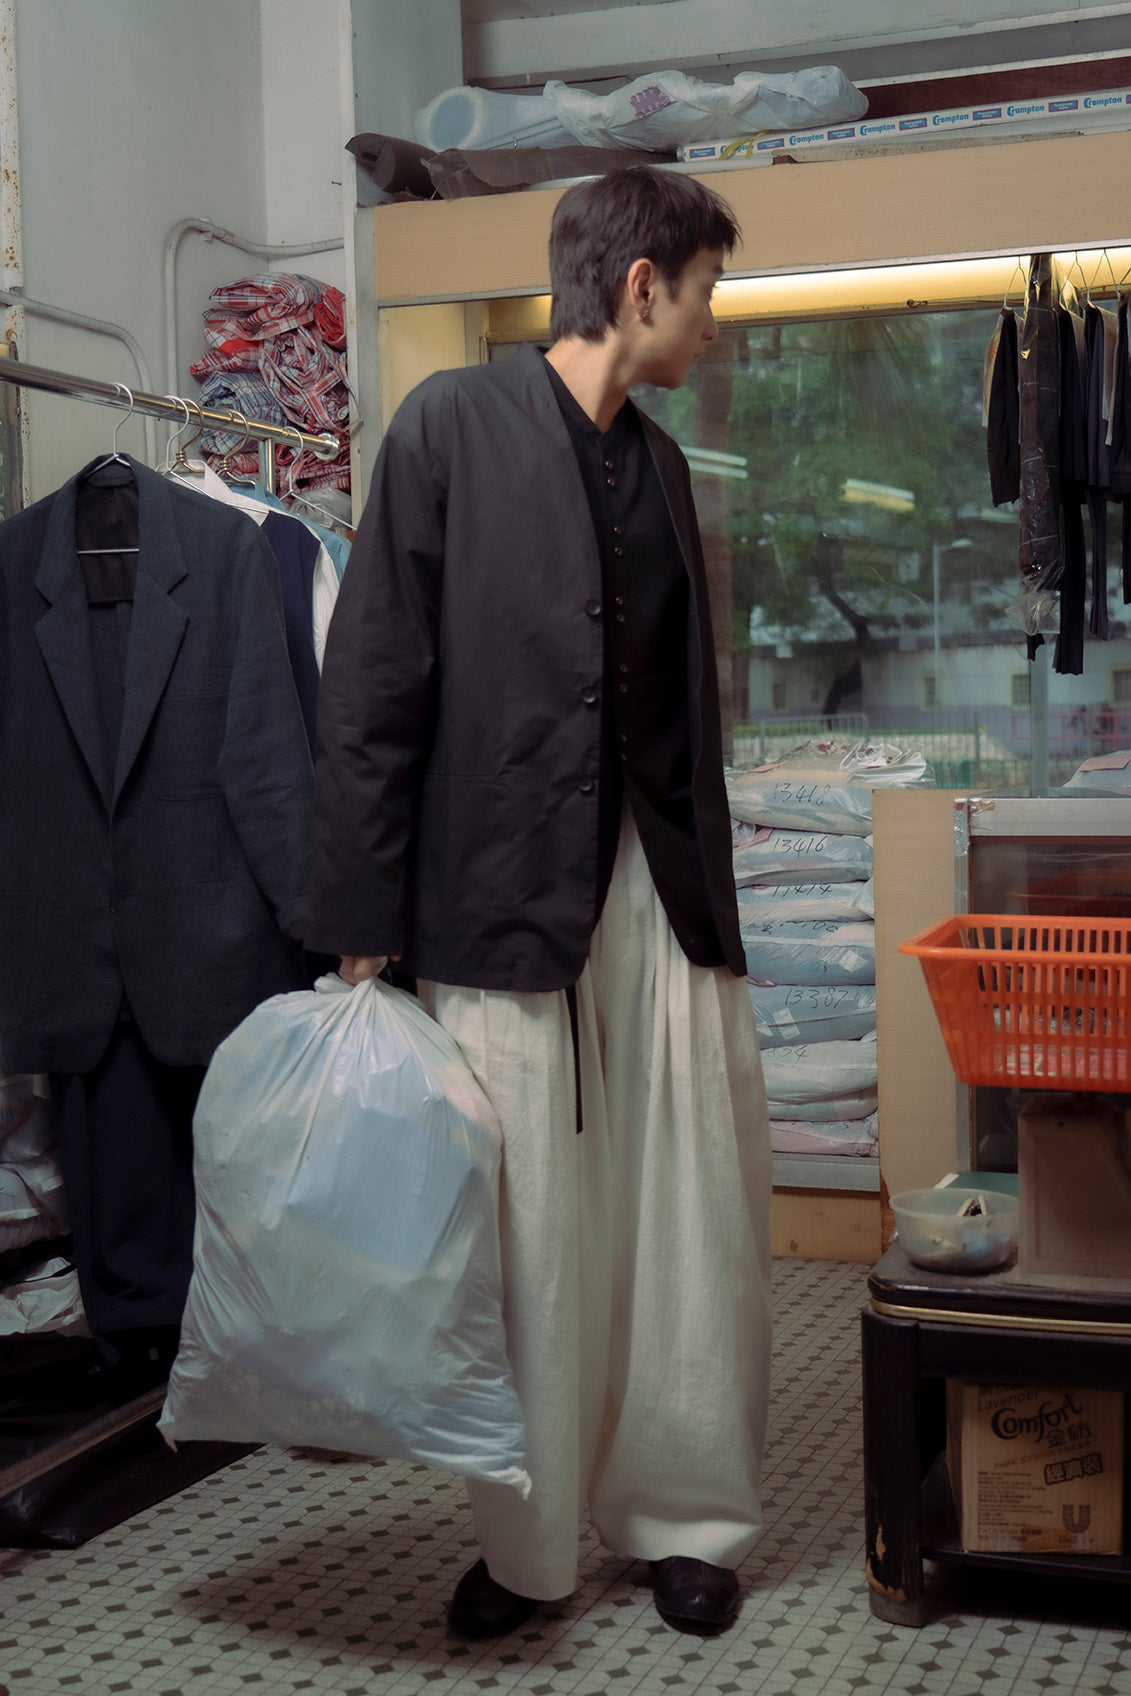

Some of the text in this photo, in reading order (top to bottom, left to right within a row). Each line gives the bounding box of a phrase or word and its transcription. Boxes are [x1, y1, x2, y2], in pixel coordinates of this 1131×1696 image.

[789, 133, 824, 146] Crompton
[860, 123, 896, 136] Crompton
[932, 113, 969, 126] Crompton
[1007, 104, 1045, 117] Crompton
[1083, 96, 1122, 109] Crompton
[772, 835, 827, 857] 13416
[977, 1388, 1039, 1412] Lavender
[991, 1392, 1082, 1443] Comfort
